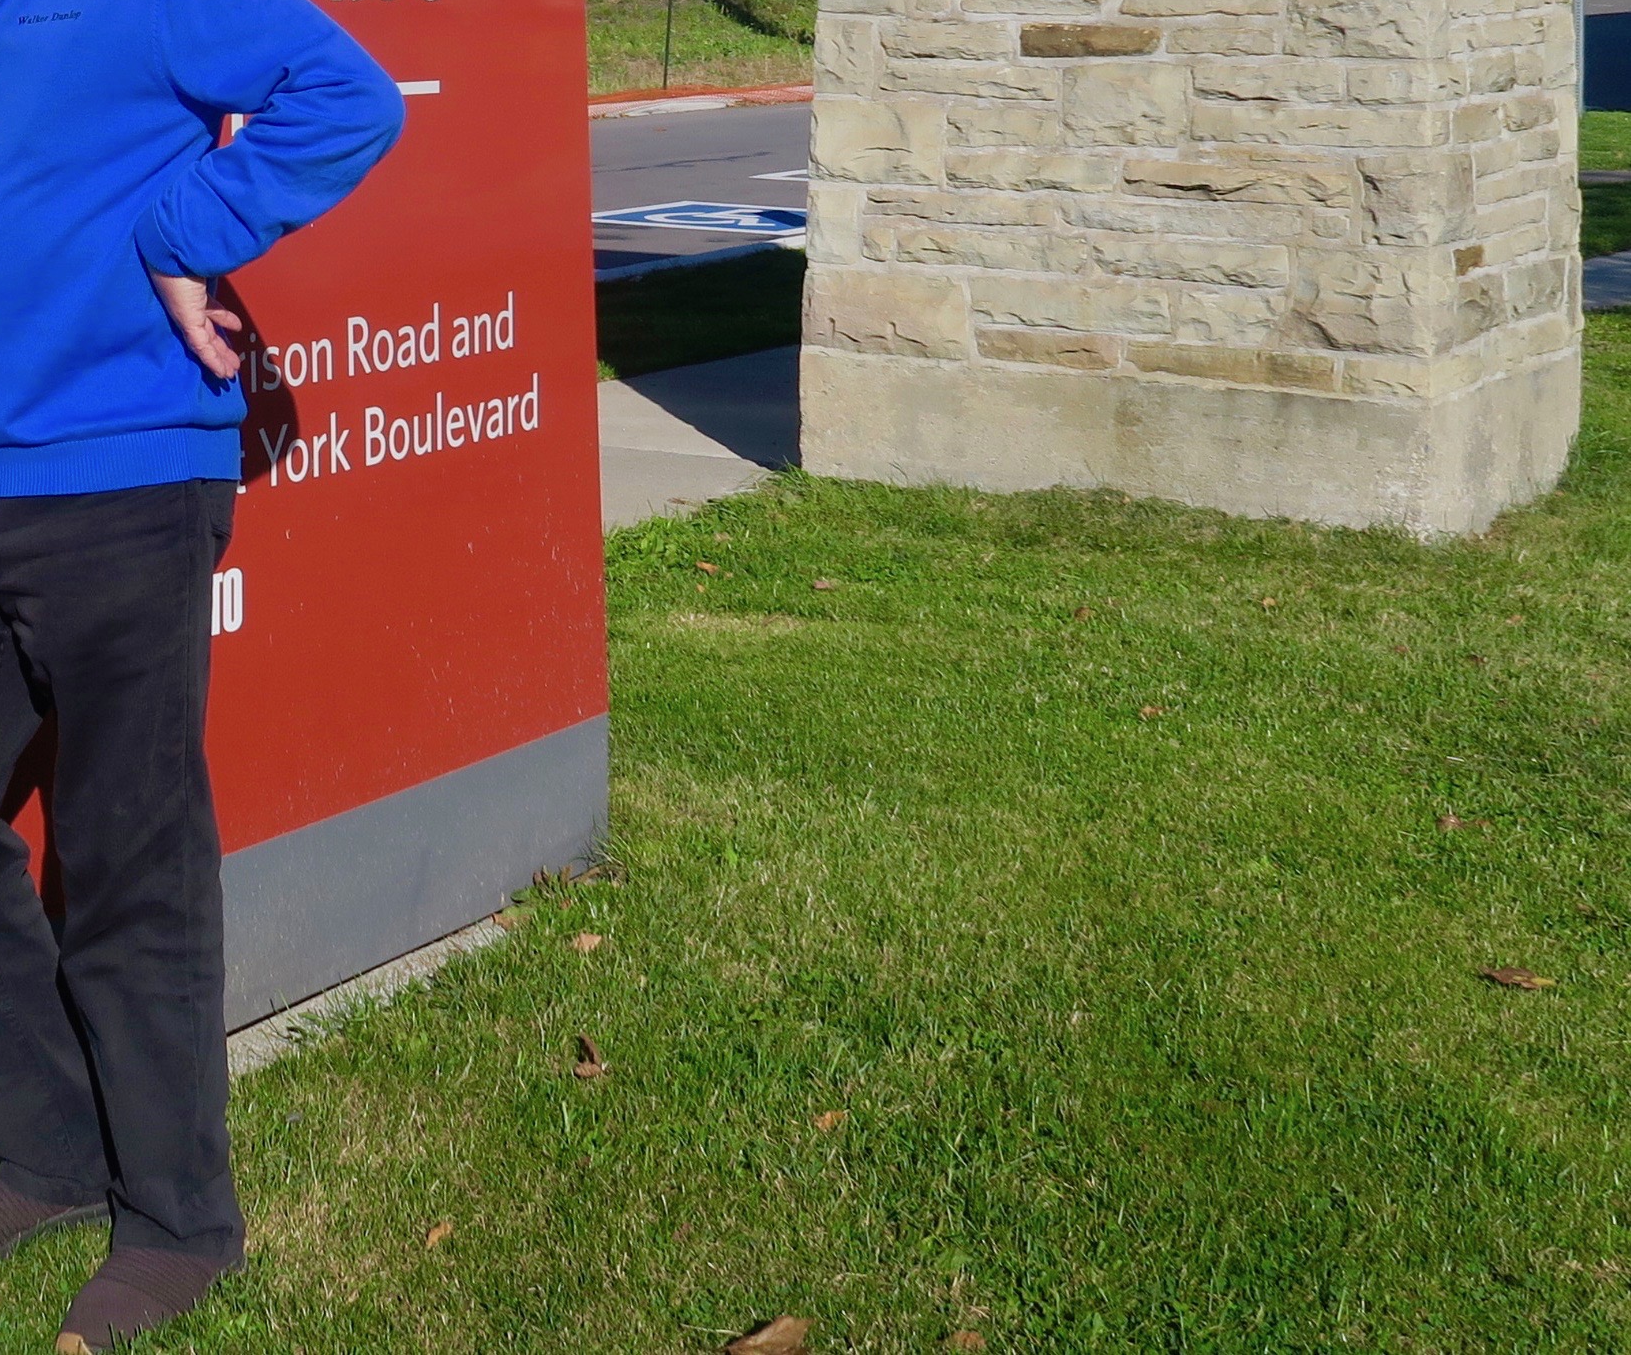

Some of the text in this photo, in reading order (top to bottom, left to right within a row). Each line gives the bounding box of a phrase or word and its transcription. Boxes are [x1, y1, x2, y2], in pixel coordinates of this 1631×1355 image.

[19, 14, 48, 25] Walker
[238, 290, 514, 393] ison Road and
[259, 412, 351, 487] York
[364, 372, 539, 467] Boulevard
